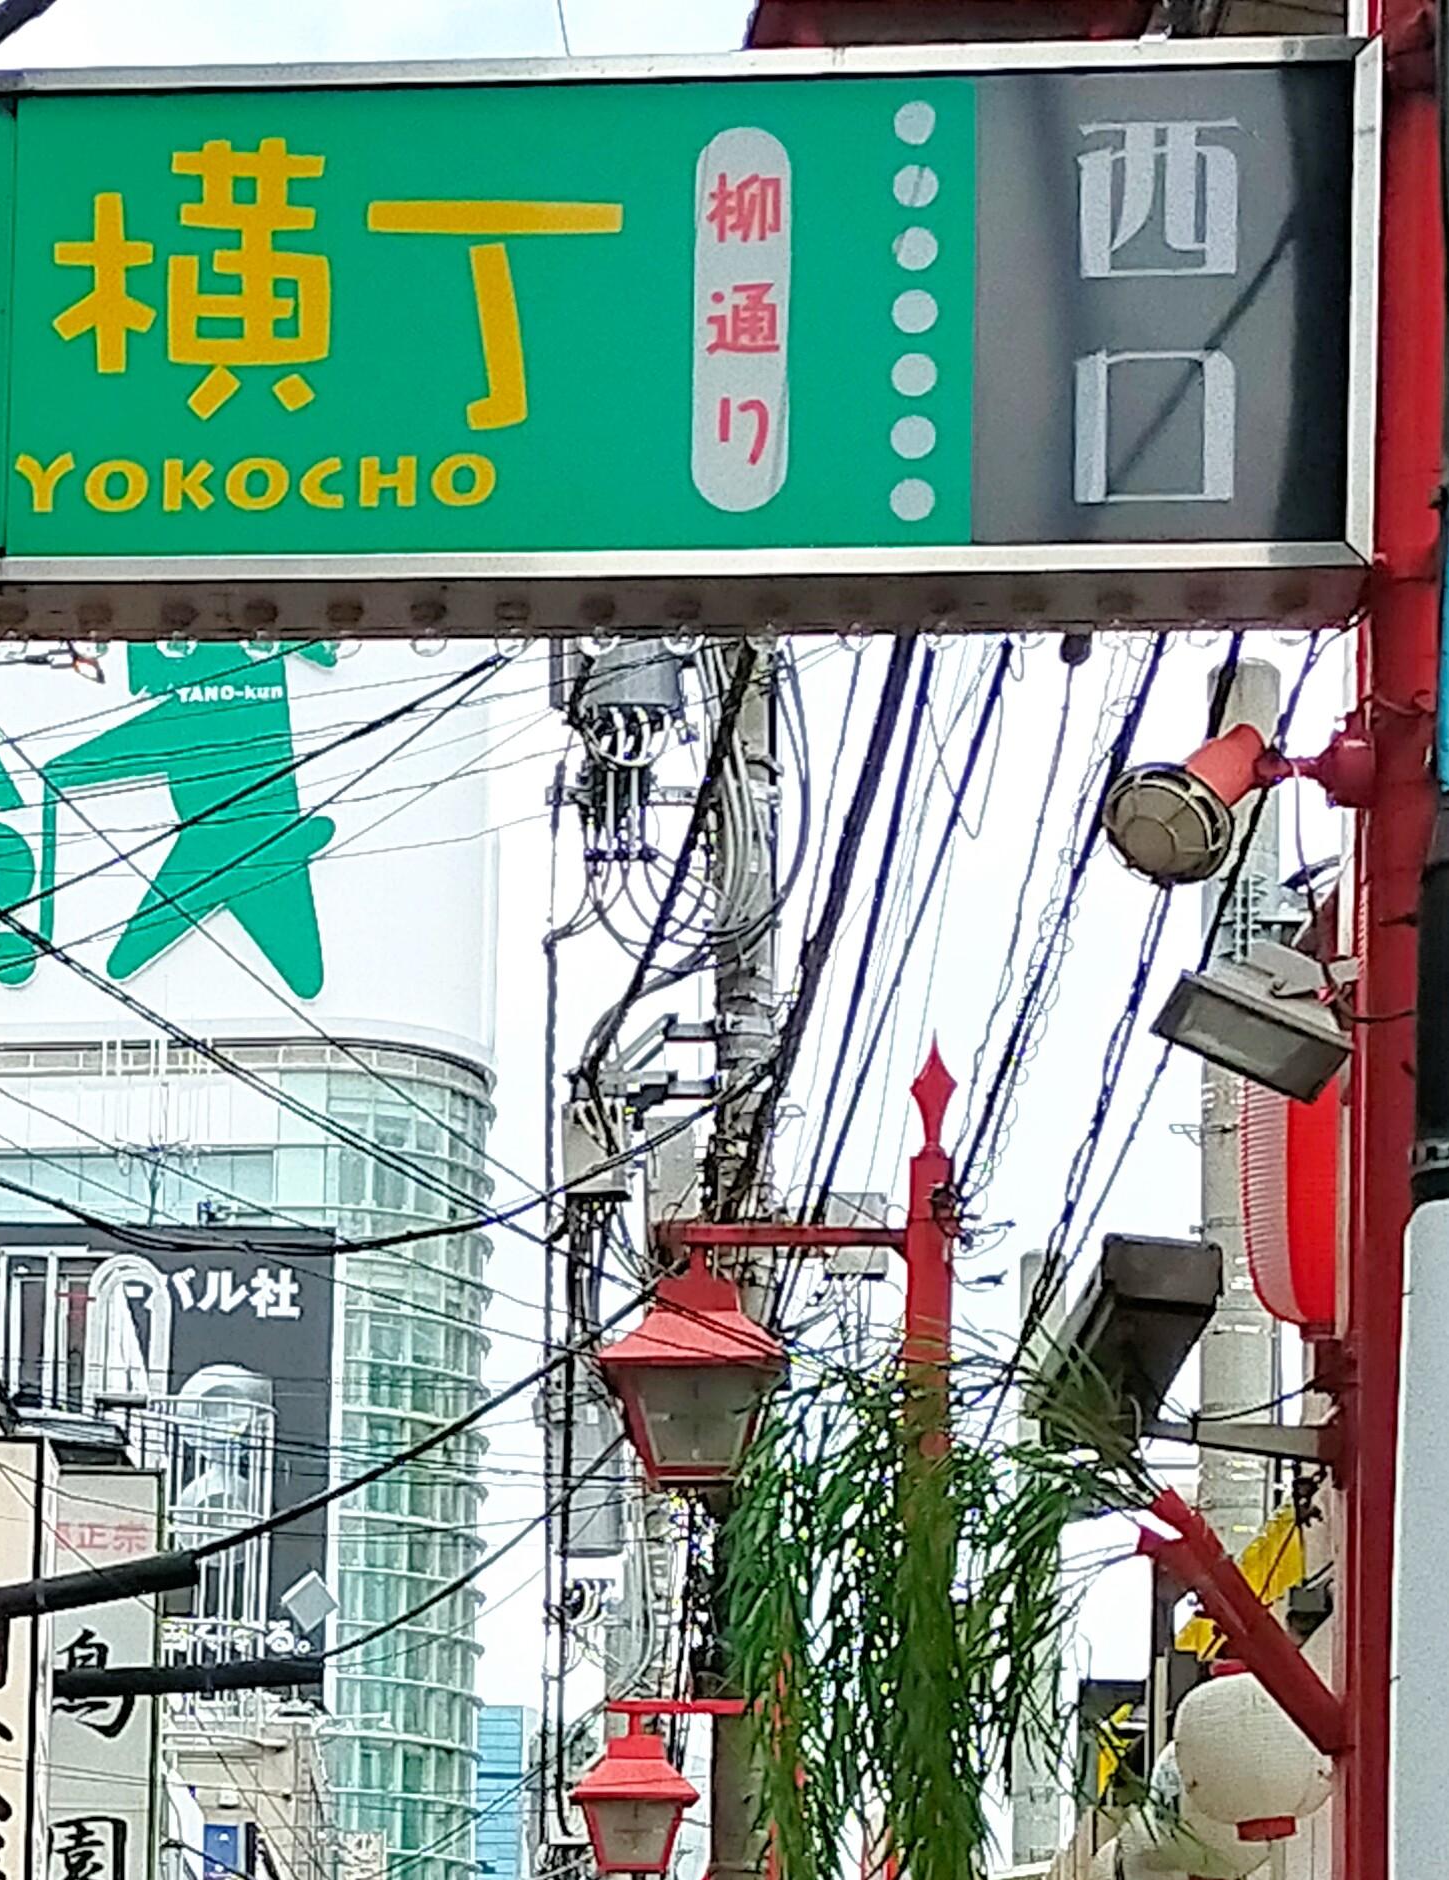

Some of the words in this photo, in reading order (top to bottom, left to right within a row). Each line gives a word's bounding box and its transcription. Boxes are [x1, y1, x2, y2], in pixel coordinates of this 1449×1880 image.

[706, 172, 782, 466] 柳通り
[1073, 118, 1241, 503] 西口
[15, 453, 497, 513] YOKOCHO
